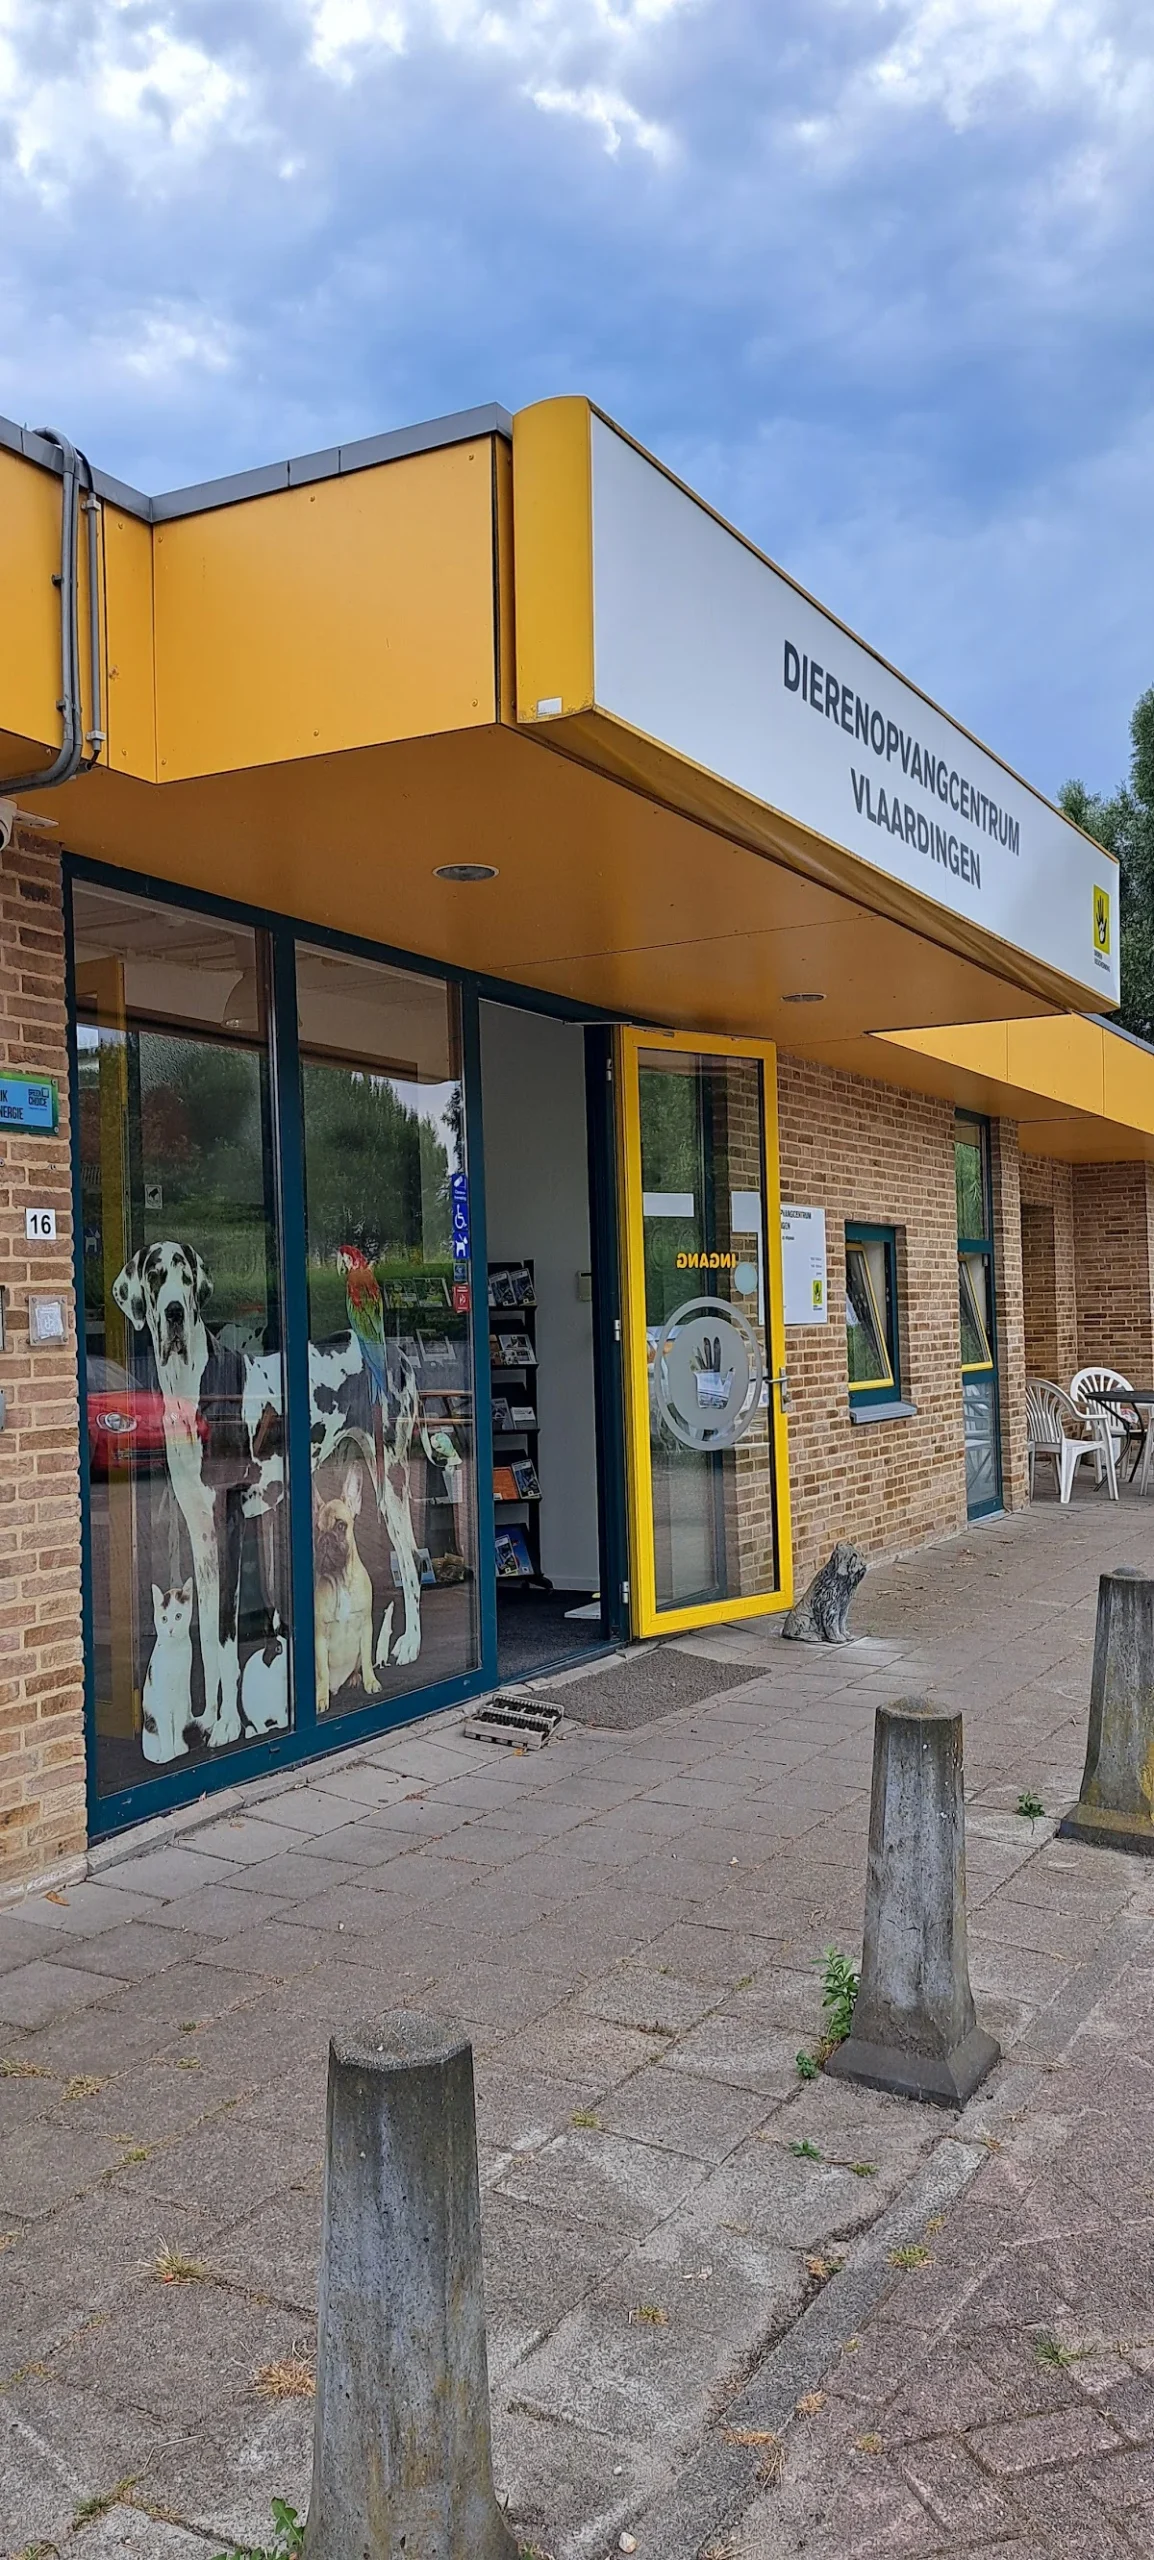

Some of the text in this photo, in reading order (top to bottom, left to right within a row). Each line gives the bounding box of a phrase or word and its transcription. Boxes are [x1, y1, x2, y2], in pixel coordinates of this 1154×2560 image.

[784, 639, 1020, 857] DIERENOPVANGCENTRUM
[850, 766, 982, 890] VLAARDINGEN
[30, 1214, 51, 1235] 16
